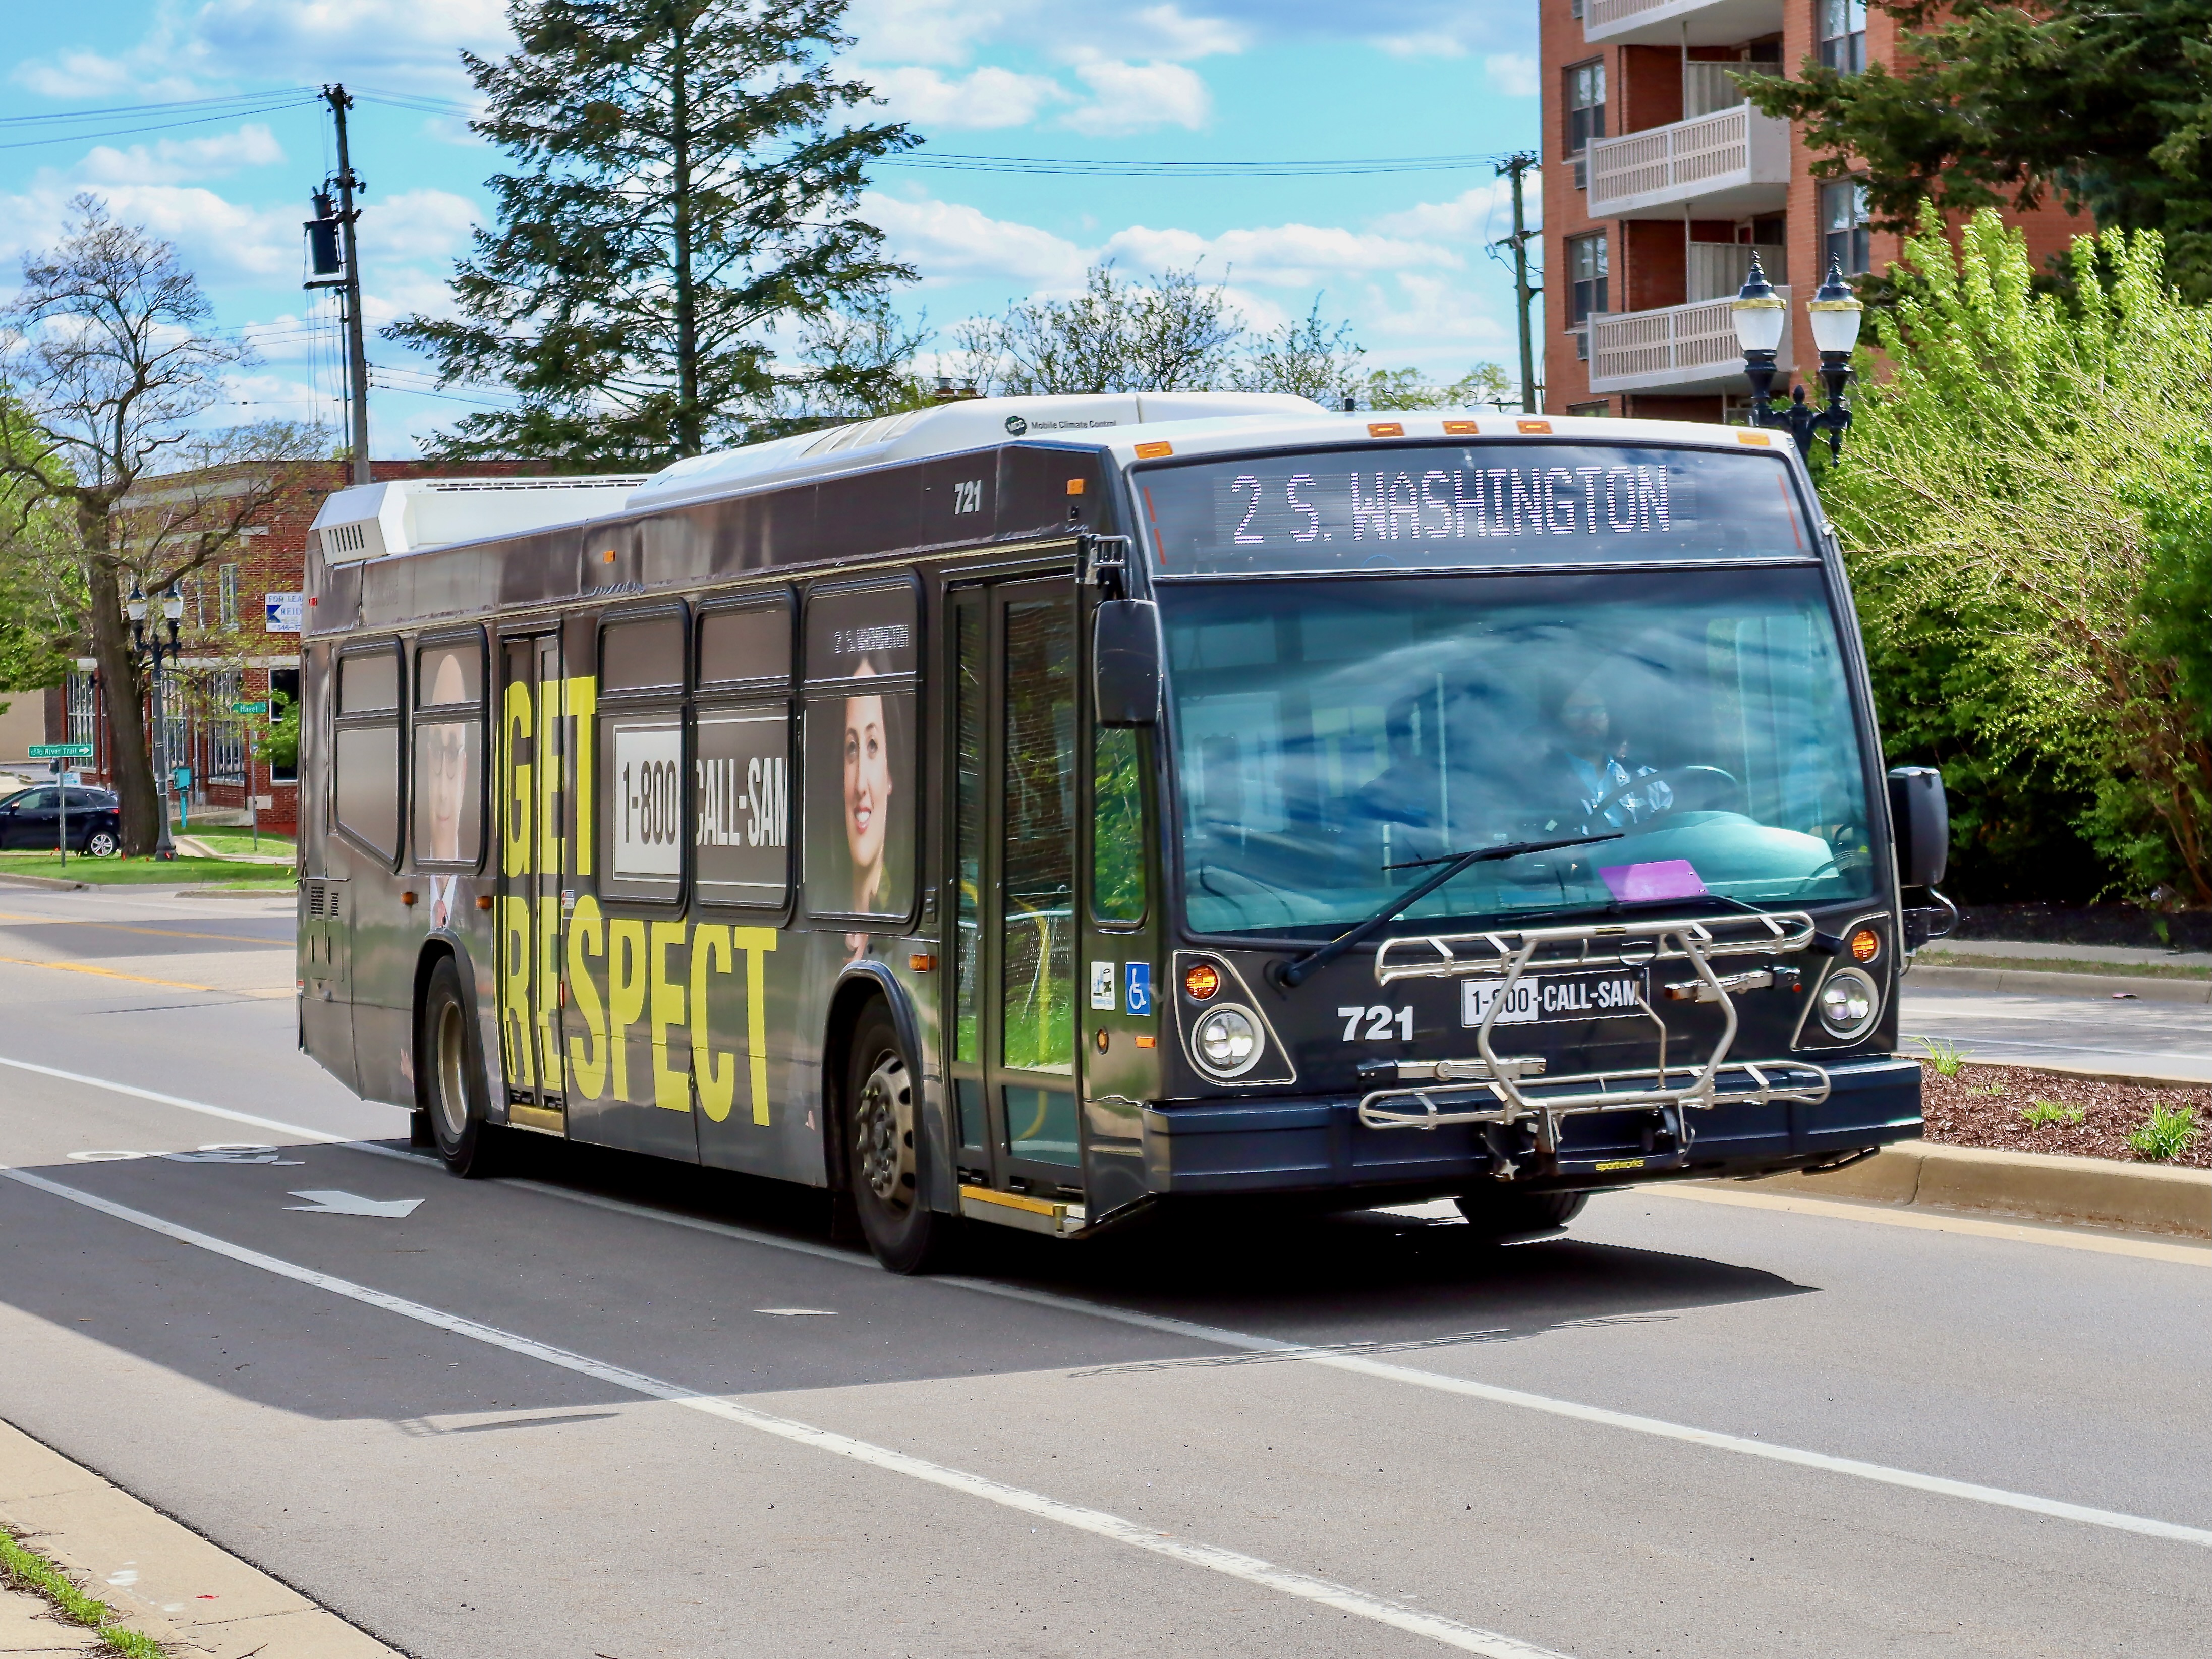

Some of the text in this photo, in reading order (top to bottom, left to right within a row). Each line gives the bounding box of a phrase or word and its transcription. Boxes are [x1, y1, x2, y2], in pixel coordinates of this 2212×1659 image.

[1031, 420, 1117, 430] Mobile Climate Control
[954, 480, 982, 515] 721
[1231, 465, 1670, 545] 2 S. WASHINGTON
[834, 631, 842, 653] 2
[495, 676, 595, 878] GET
[623, 761, 676, 845] 1-800
[493, 895, 777, 1126] RESPECT
[1338, 1006, 1413, 1041] 721
